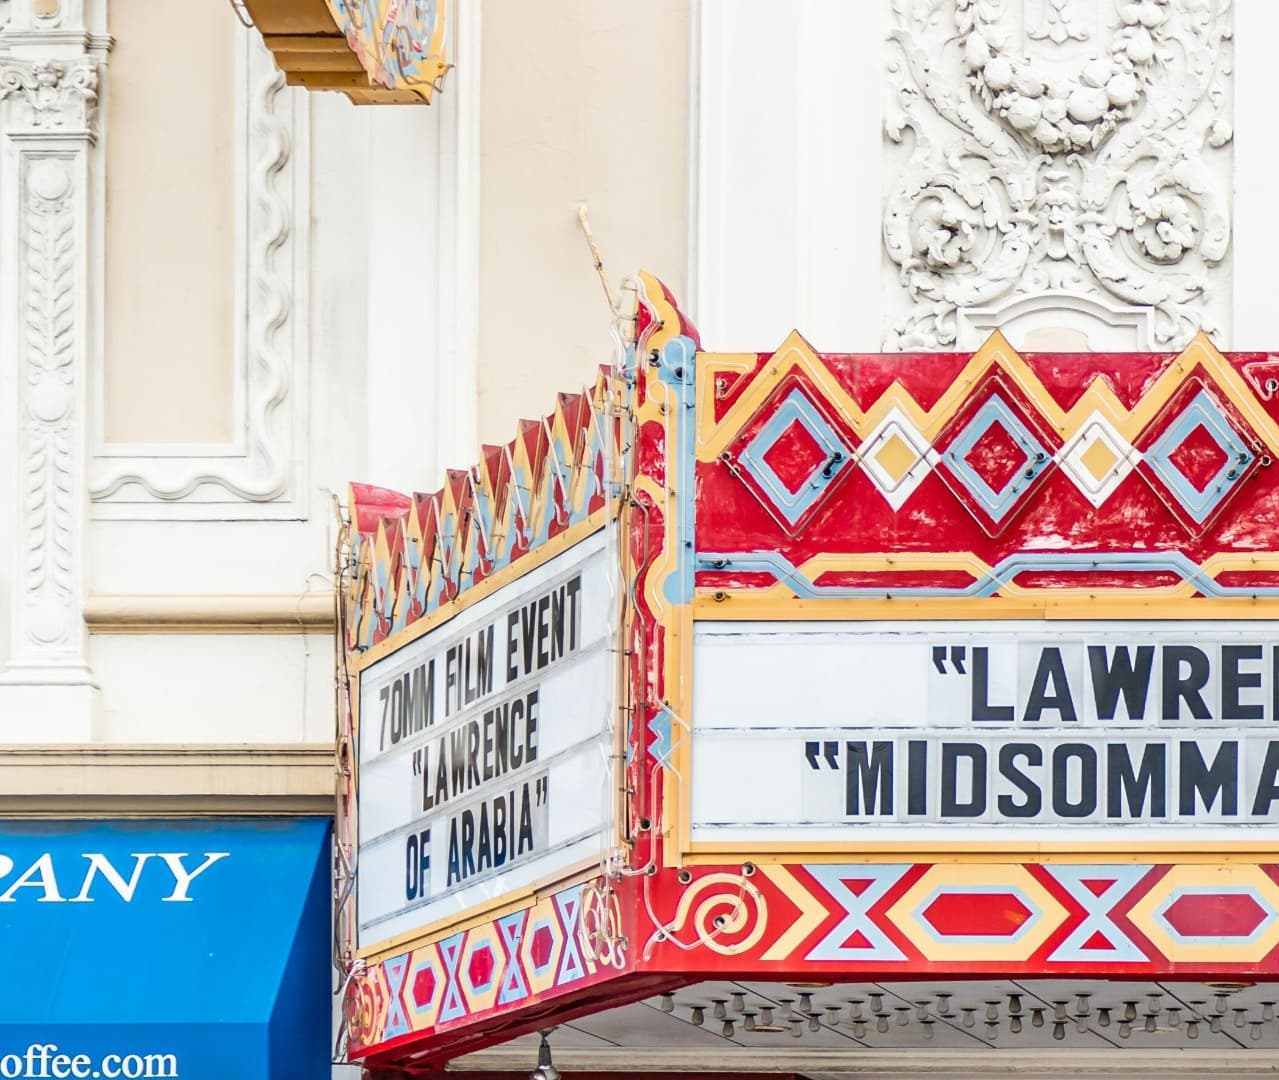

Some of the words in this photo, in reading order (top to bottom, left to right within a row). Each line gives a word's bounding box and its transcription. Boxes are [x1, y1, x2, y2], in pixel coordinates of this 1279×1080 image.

[380, 659, 435, 752] 70MM
[445, 624, 495, 718] FILM
[506, 576, 581, 683] EVENT
[412, 690, 539, 812] "LAWRENCE
[0, 852, 231, 903] ANY
[405, 829, 432, 901] OF
[446, 775, 548, 888] ARABIA"
